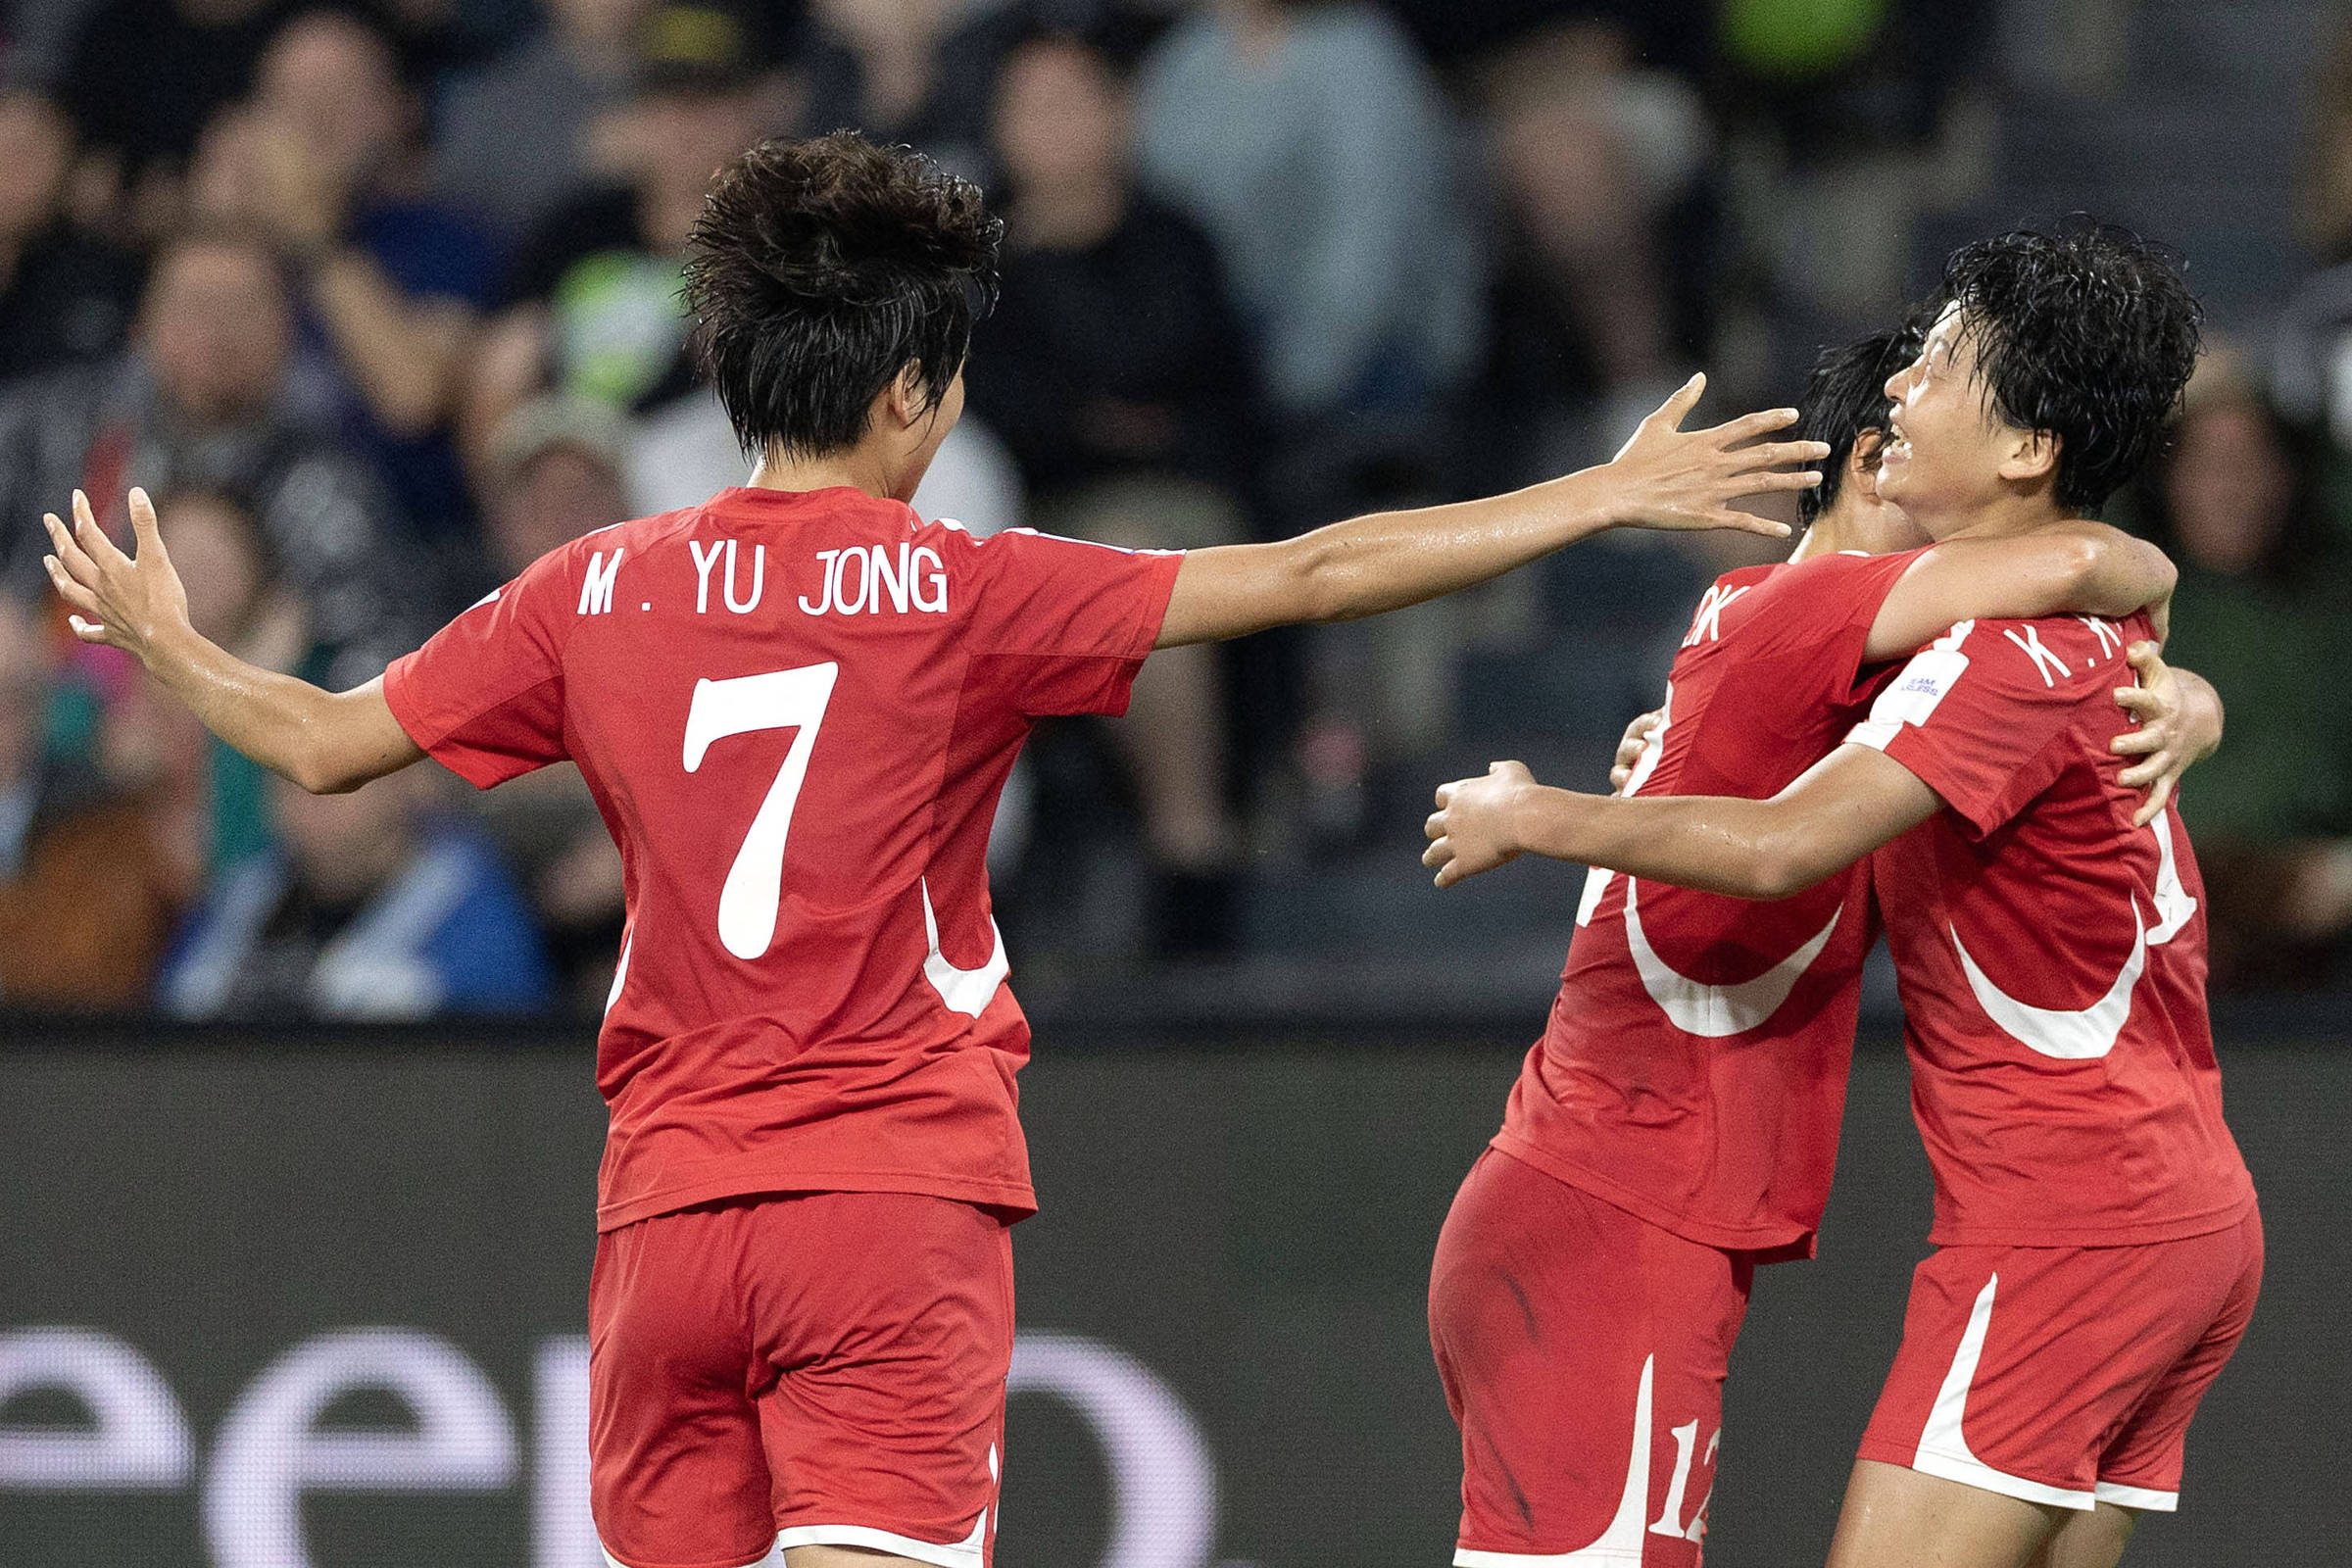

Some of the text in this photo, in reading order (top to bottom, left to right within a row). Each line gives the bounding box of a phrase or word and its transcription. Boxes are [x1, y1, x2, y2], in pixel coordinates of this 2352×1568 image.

[688, 540, 765, 614] YU
[798, 542, 948, 616] JONG
[682, 662, 839, 959] 7
